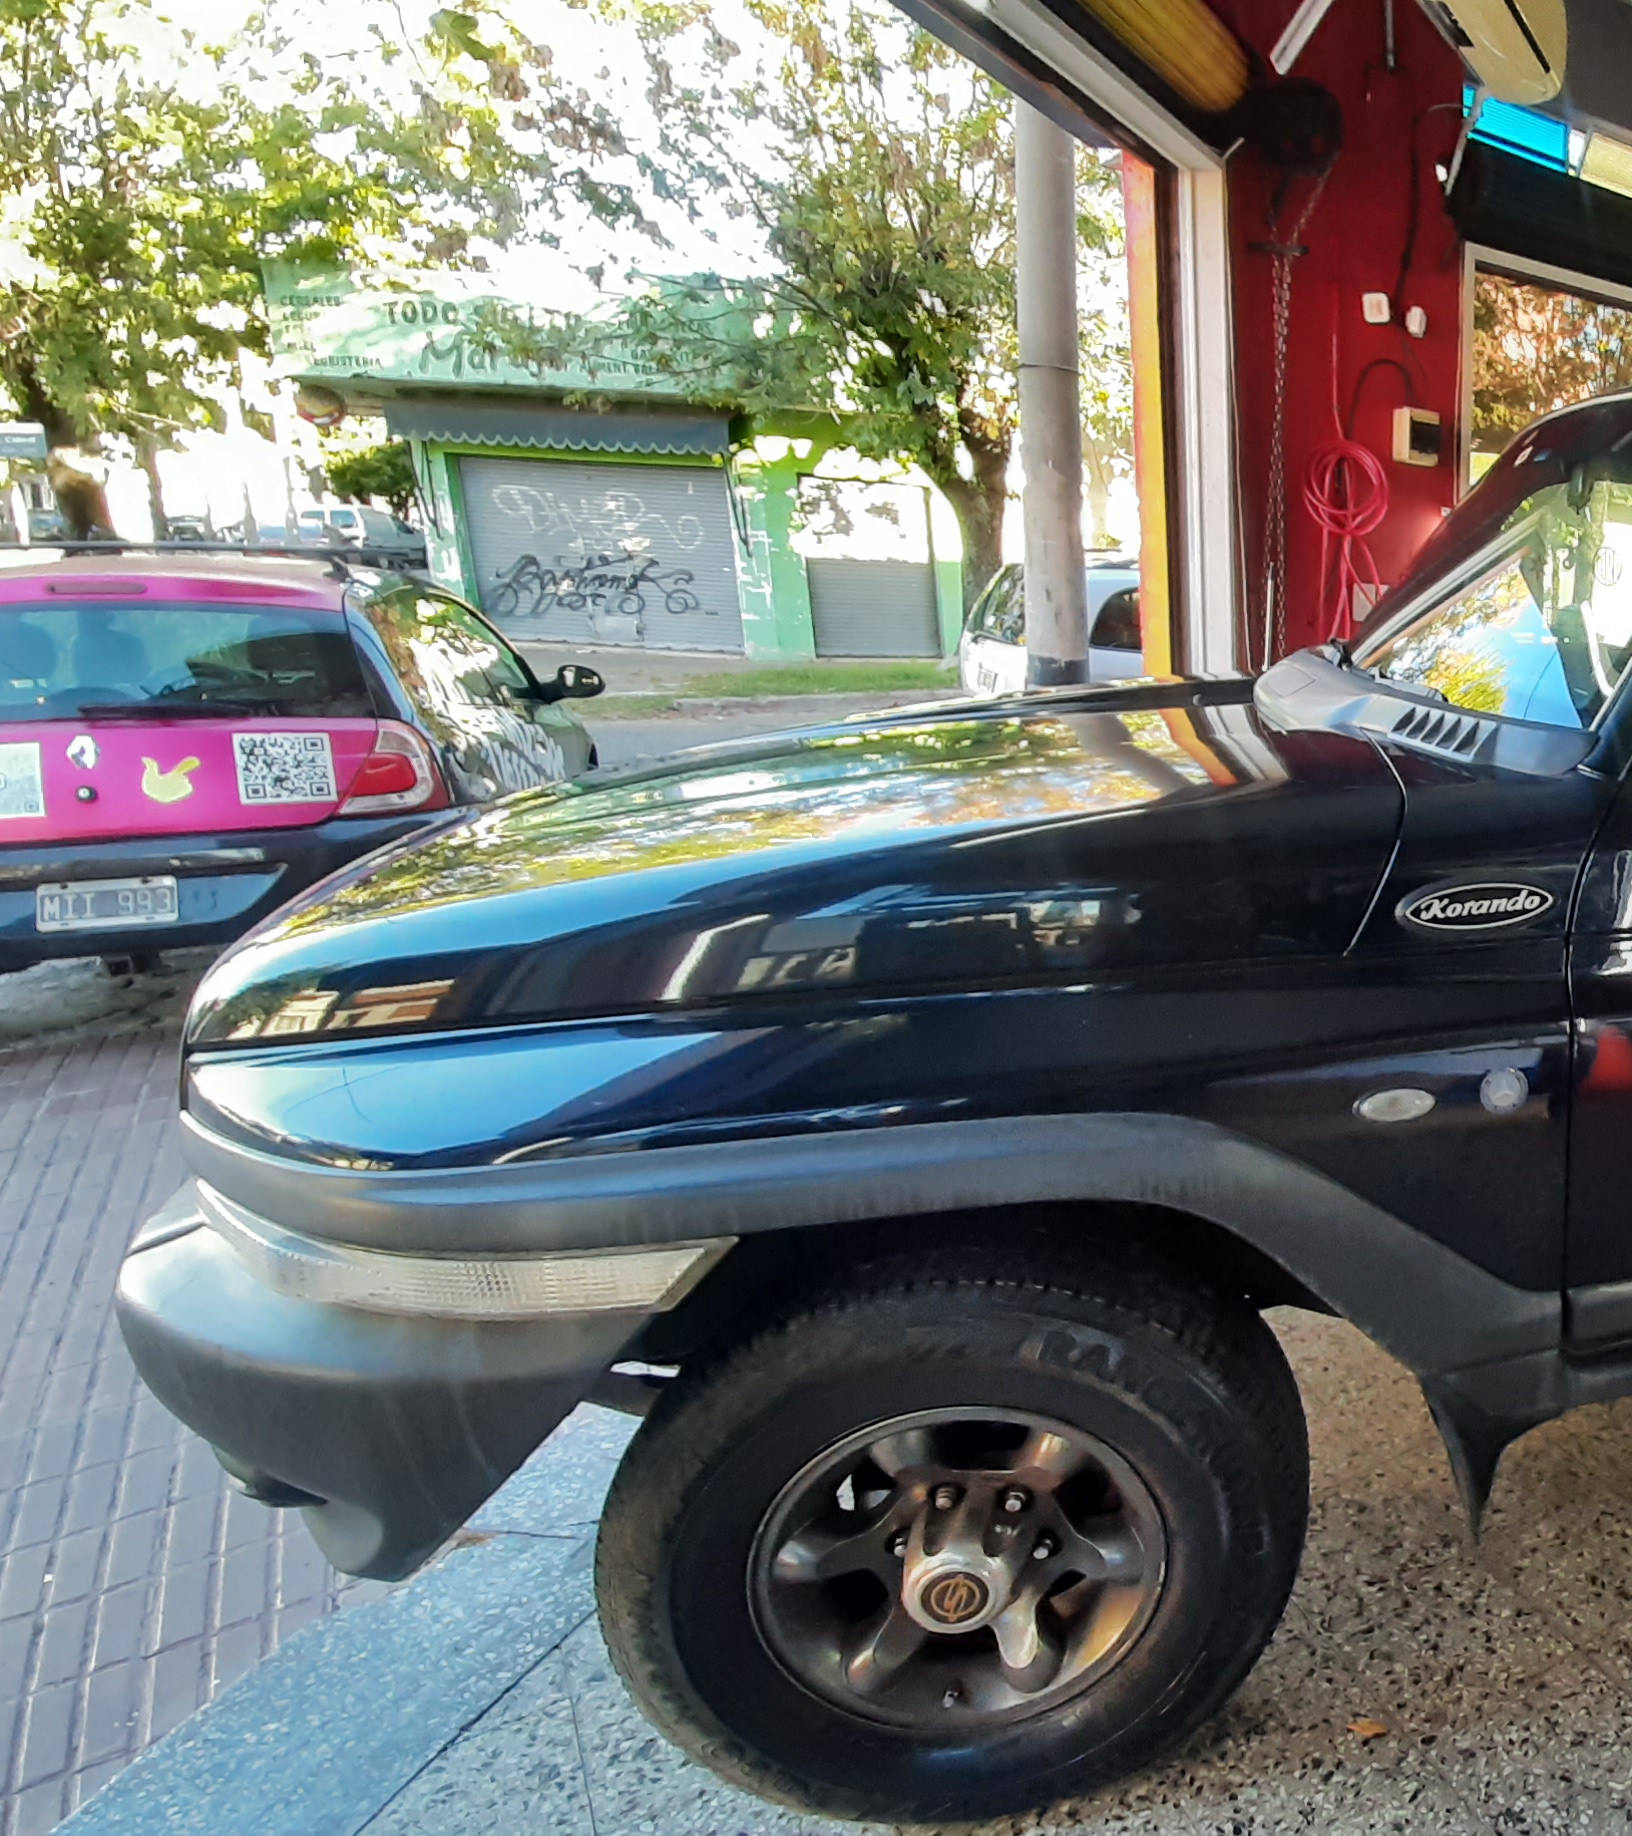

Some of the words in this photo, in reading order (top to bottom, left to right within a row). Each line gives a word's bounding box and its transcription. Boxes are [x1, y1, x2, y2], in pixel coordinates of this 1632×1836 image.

[383, 299, 460, 325] TODO
[42, 891, 97, 921] MII
[117, 887, 172, 915] 993
[1420, 889, 1541, 921] Korando
